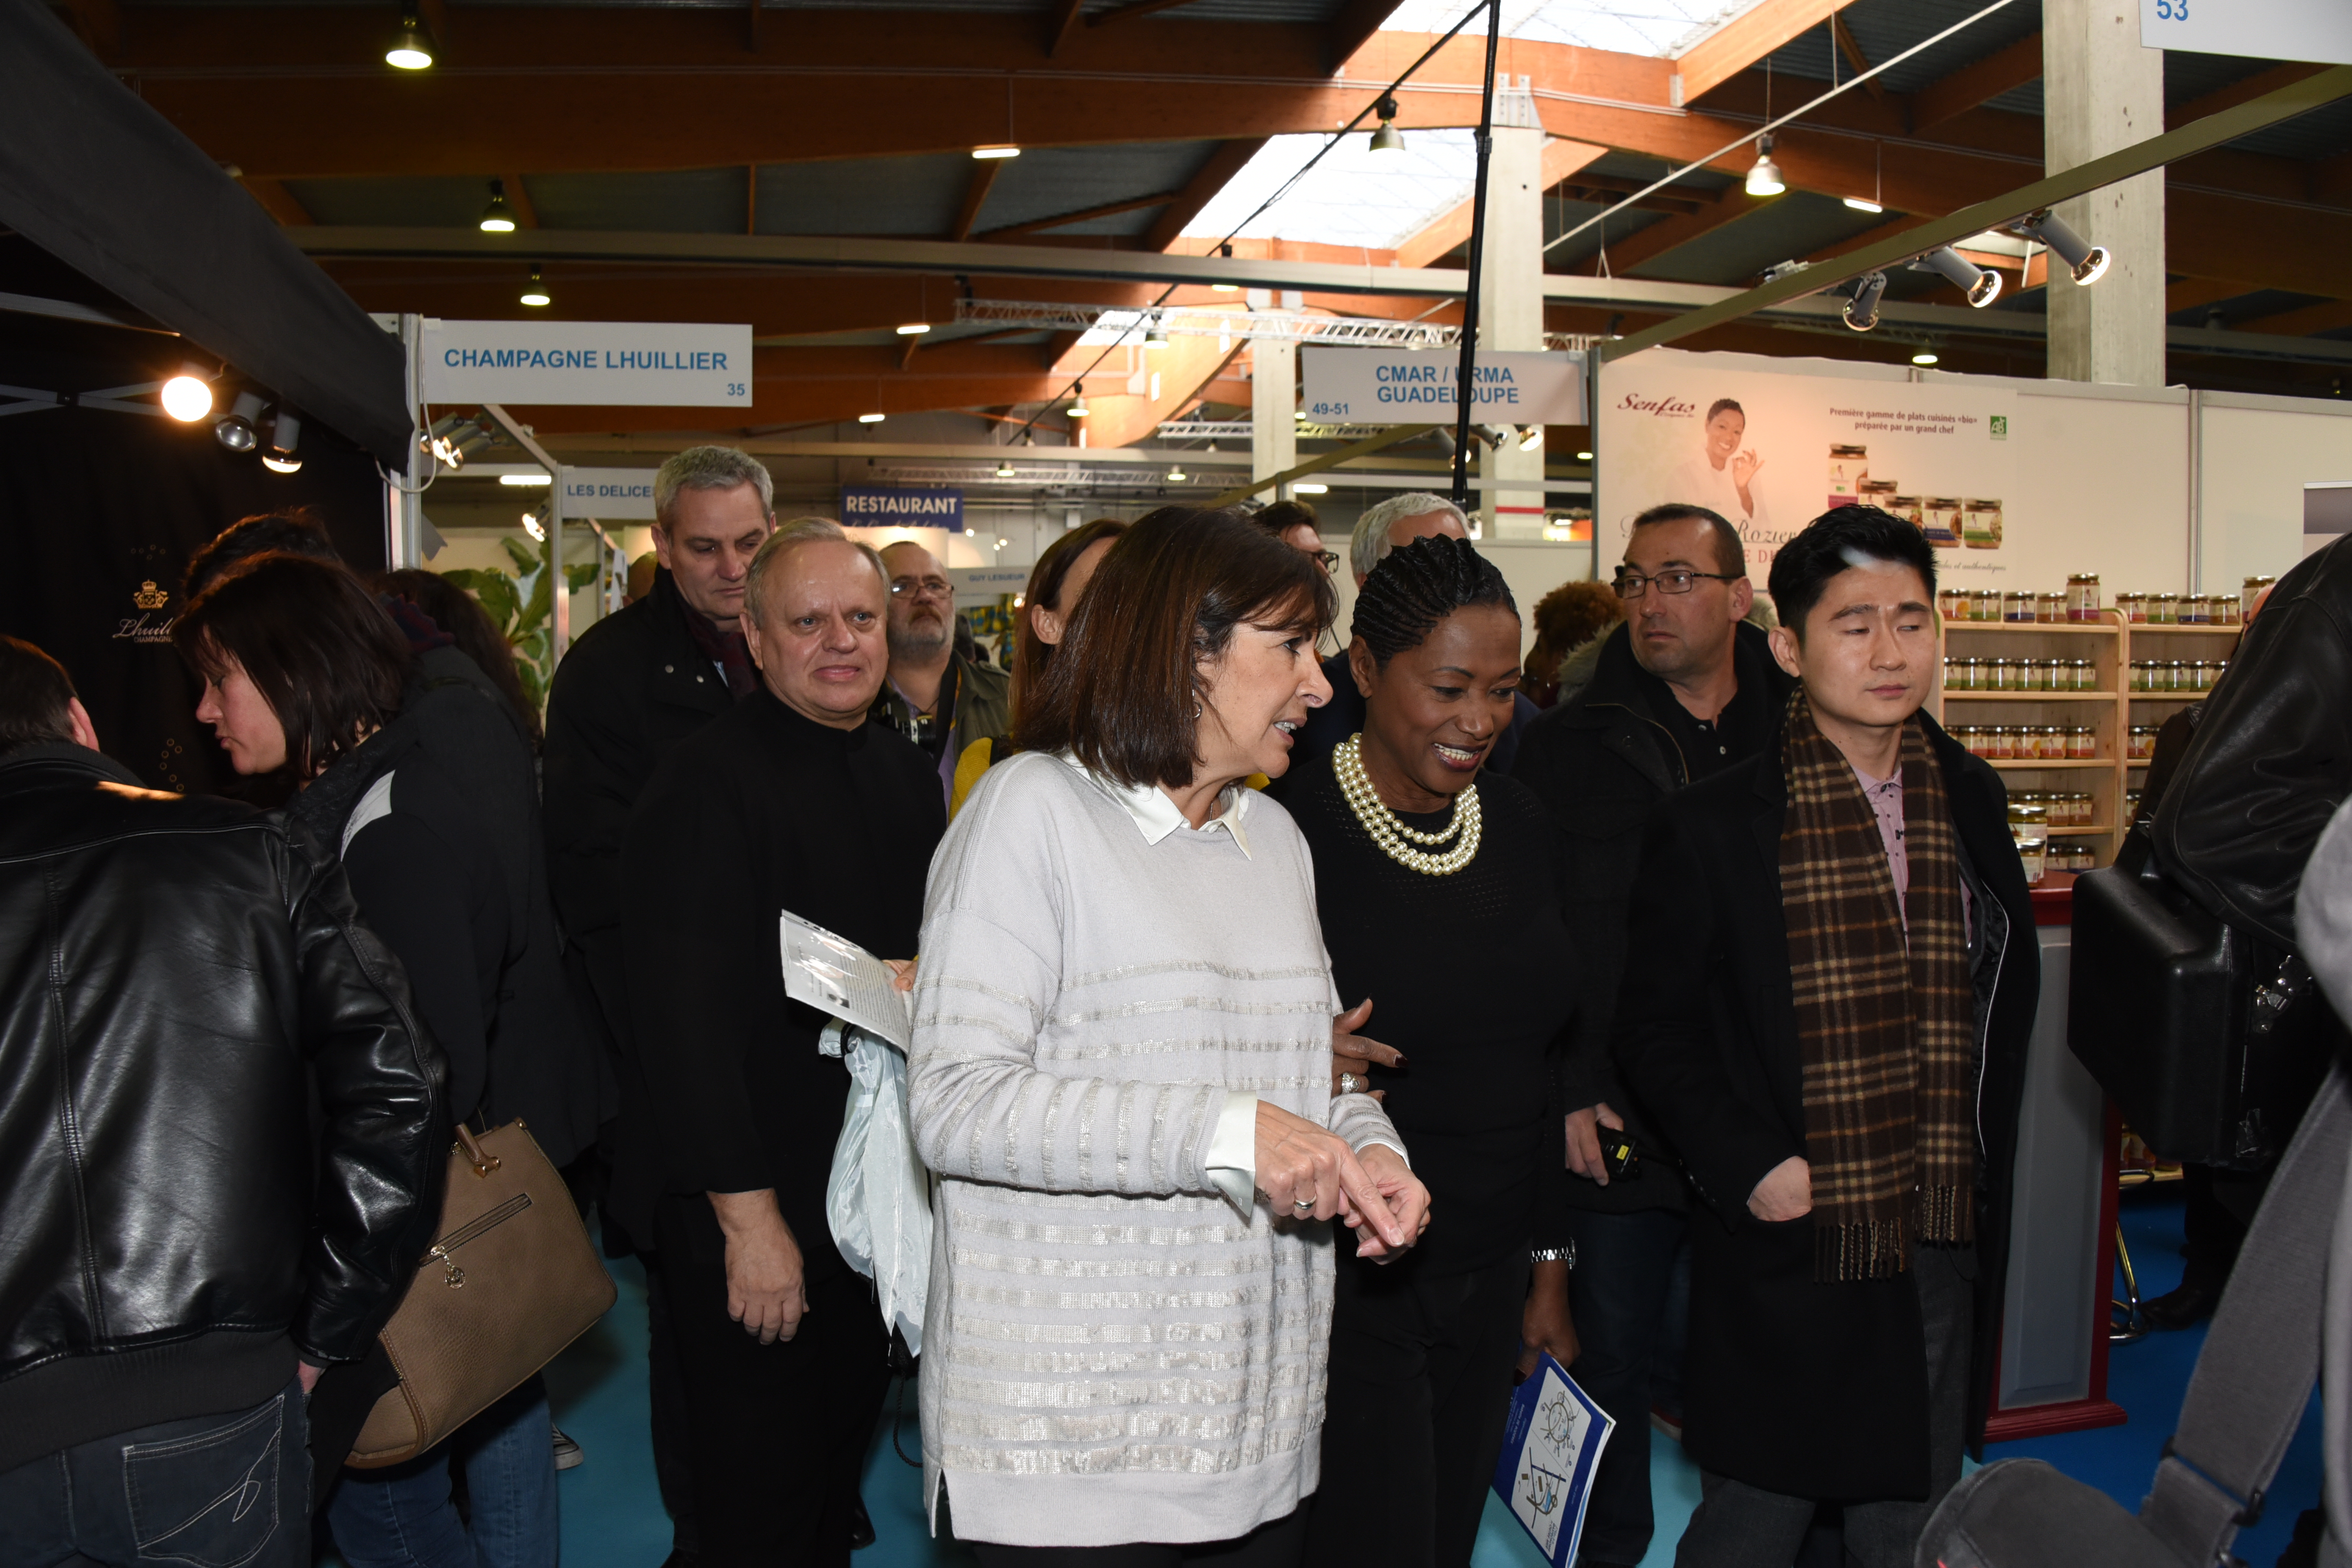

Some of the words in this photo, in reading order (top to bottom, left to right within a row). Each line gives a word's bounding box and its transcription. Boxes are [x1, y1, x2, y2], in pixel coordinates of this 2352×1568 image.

[2157, 0, 2189, 21] 53
[444, 348, 598, 368] CHAMPAGNE
[606, 351, 728, 370] LHUILLIER
[1376, 365, 1437, 383] CMAR
[1442, 366, 1449, 382] /
[1454, 367, 1514, 384] RMA
[727, 383, 745, 396] 35
[1312, 403, 1349, 415] 49-51
[1617, 393, 1695, 416] Senfas
[1830, 407, 1864, 417] Première
[1866, 410, 1894, 419] gamme
[1896, 411, 1905, 419] de
[1907, 412, 1925, 422] plats
[1927, 413, 1955, 423] cuisinés
[1855, 421, 1888, 431] préparée
[1916, 424, 1937, 434] grand
[567, 484, 595, 496] LES
[599, 485, 655, 498] DELICE
[846, 495, 957, 514] RESTAURANT
